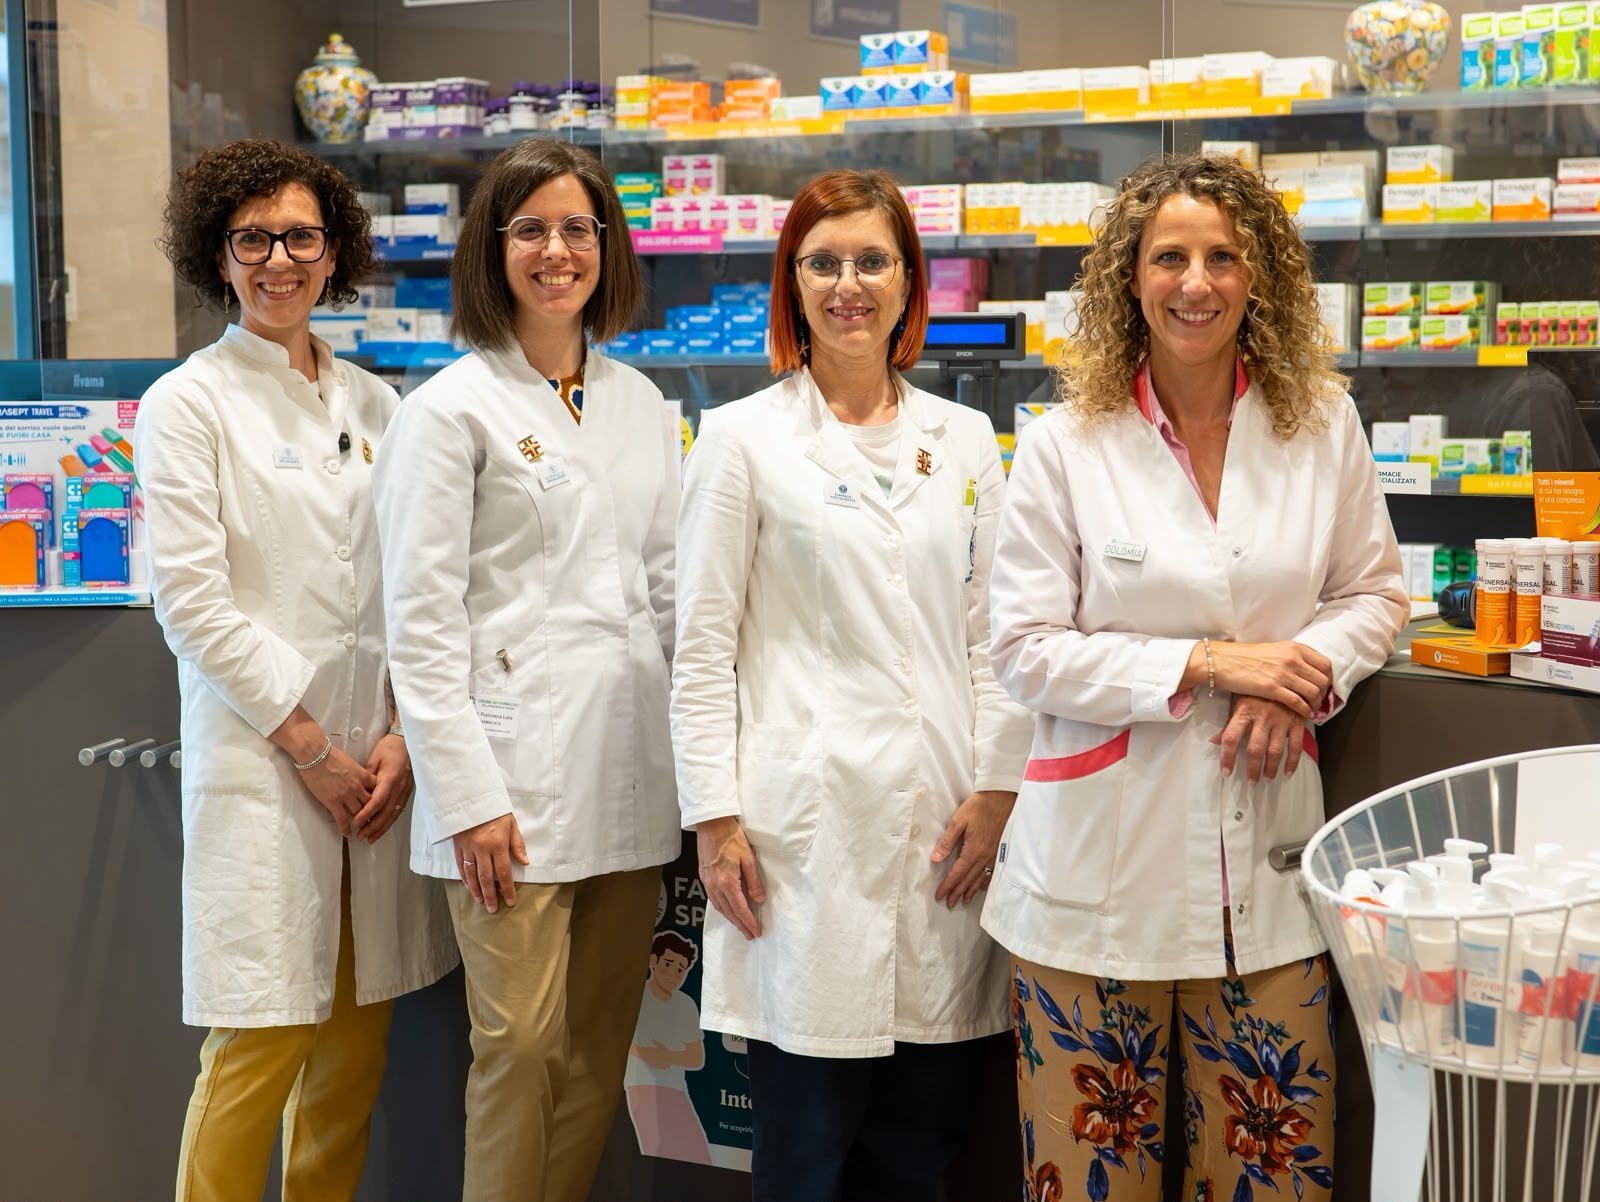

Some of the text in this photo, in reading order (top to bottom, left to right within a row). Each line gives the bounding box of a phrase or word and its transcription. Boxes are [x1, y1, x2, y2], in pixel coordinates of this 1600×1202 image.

[32, 408, 54, 416] TRAVEL
[1562, 488, 1584, 496] bisogno
[1104, 544, 1142, 558] DOLOMIA
[481, 711, 503, 719] Francesca
[674, 877, 706, 900] FA
[674, 904, 706, 927] SP
[719, 1121, 728, 1130] Per
